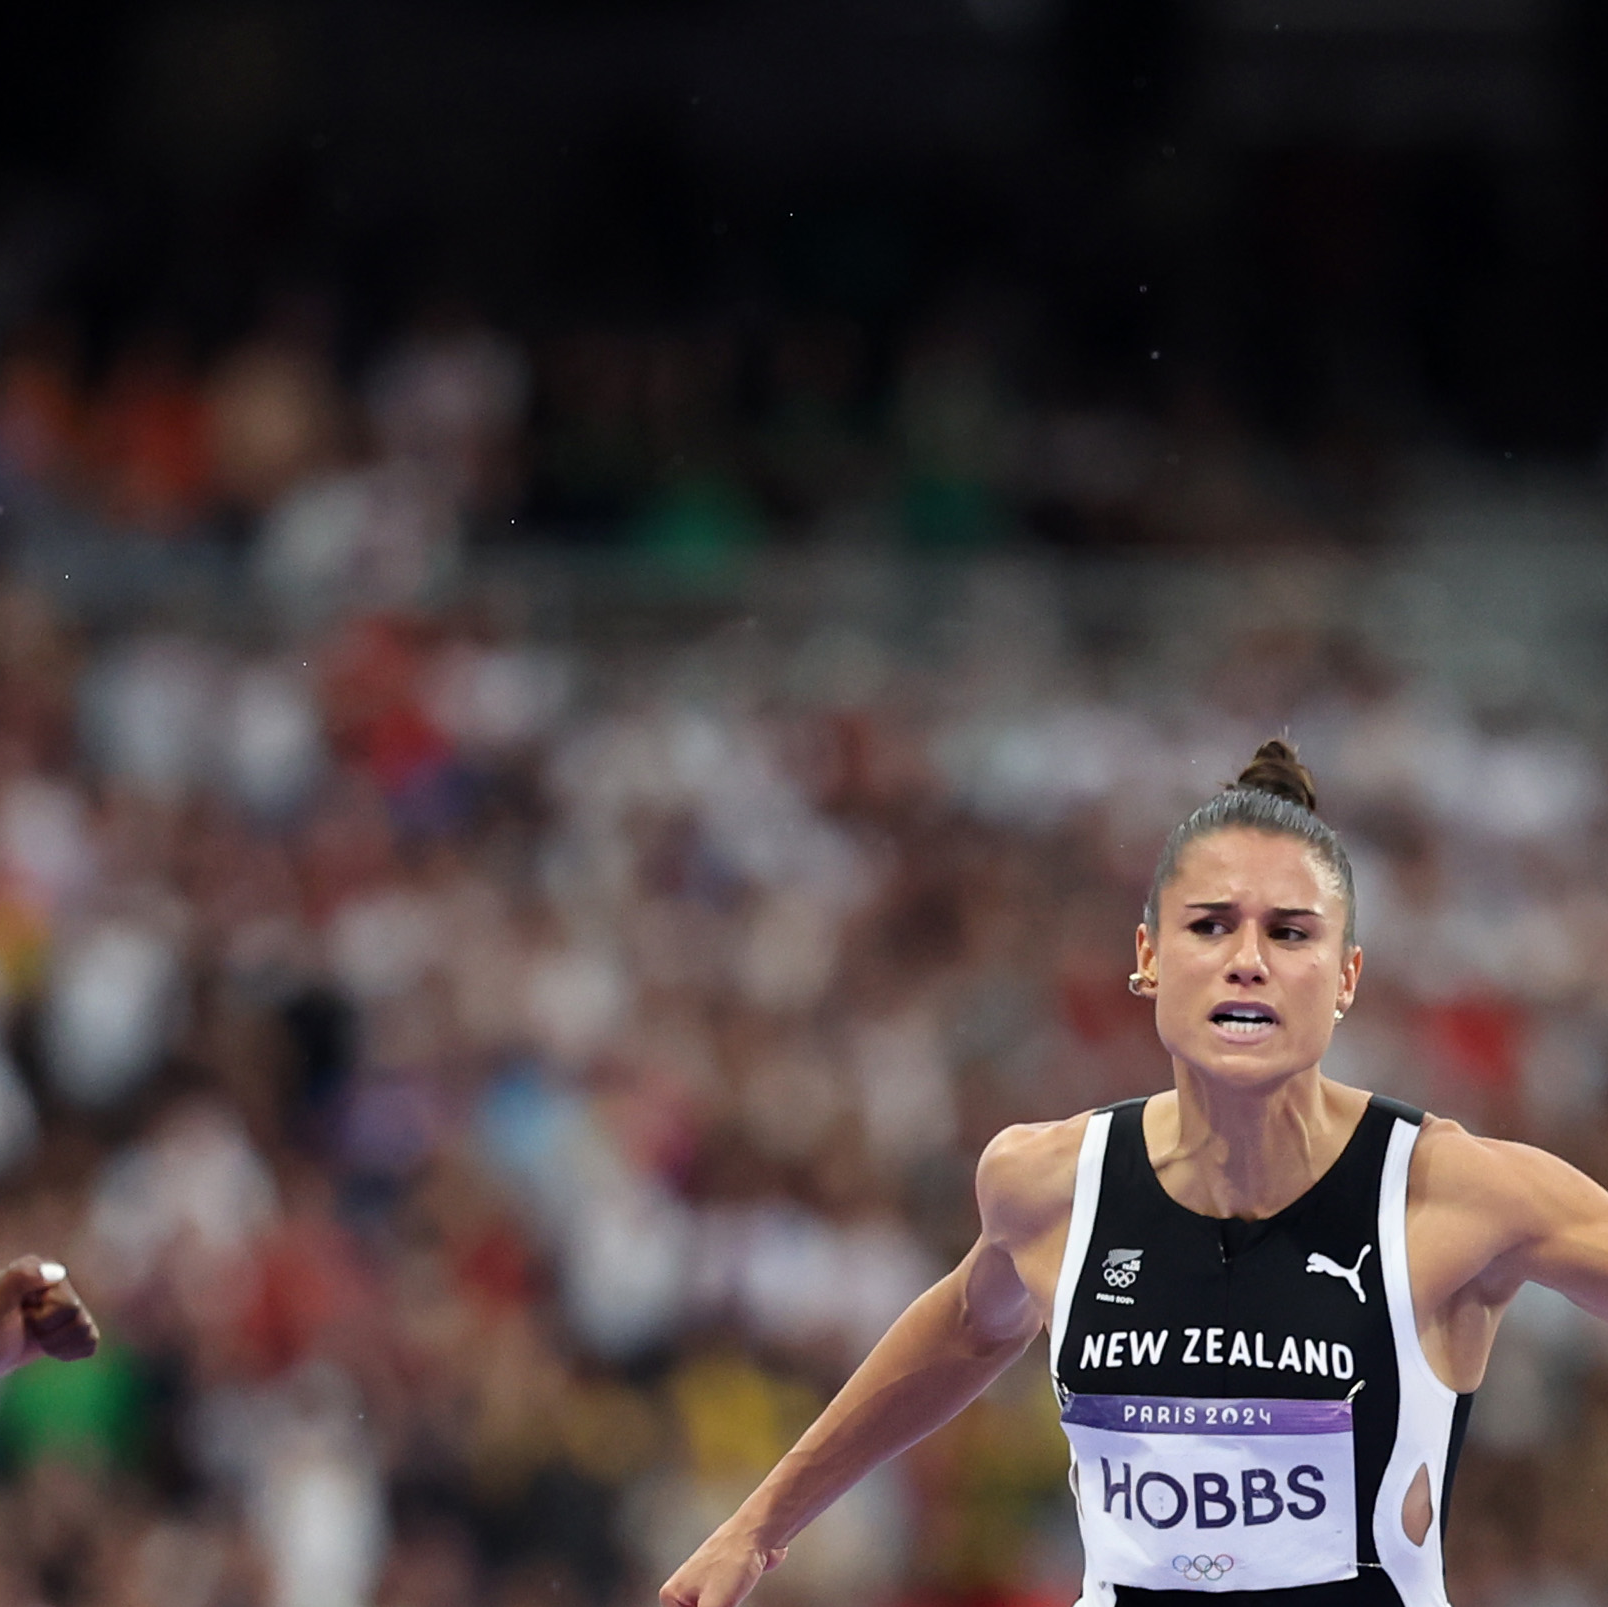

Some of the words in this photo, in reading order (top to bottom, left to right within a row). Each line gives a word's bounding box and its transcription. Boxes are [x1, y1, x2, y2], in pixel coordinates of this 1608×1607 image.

[1079, 1329, 1169, 1370] NEW
[1181, 1327, 1354, 1380] ZEALAND
[1124, 1405, 1196, 1425] PARIS
[1205, 1406, 1272, 1426] 2024
[1100, 1456, 1327, 1530] HOBBS
